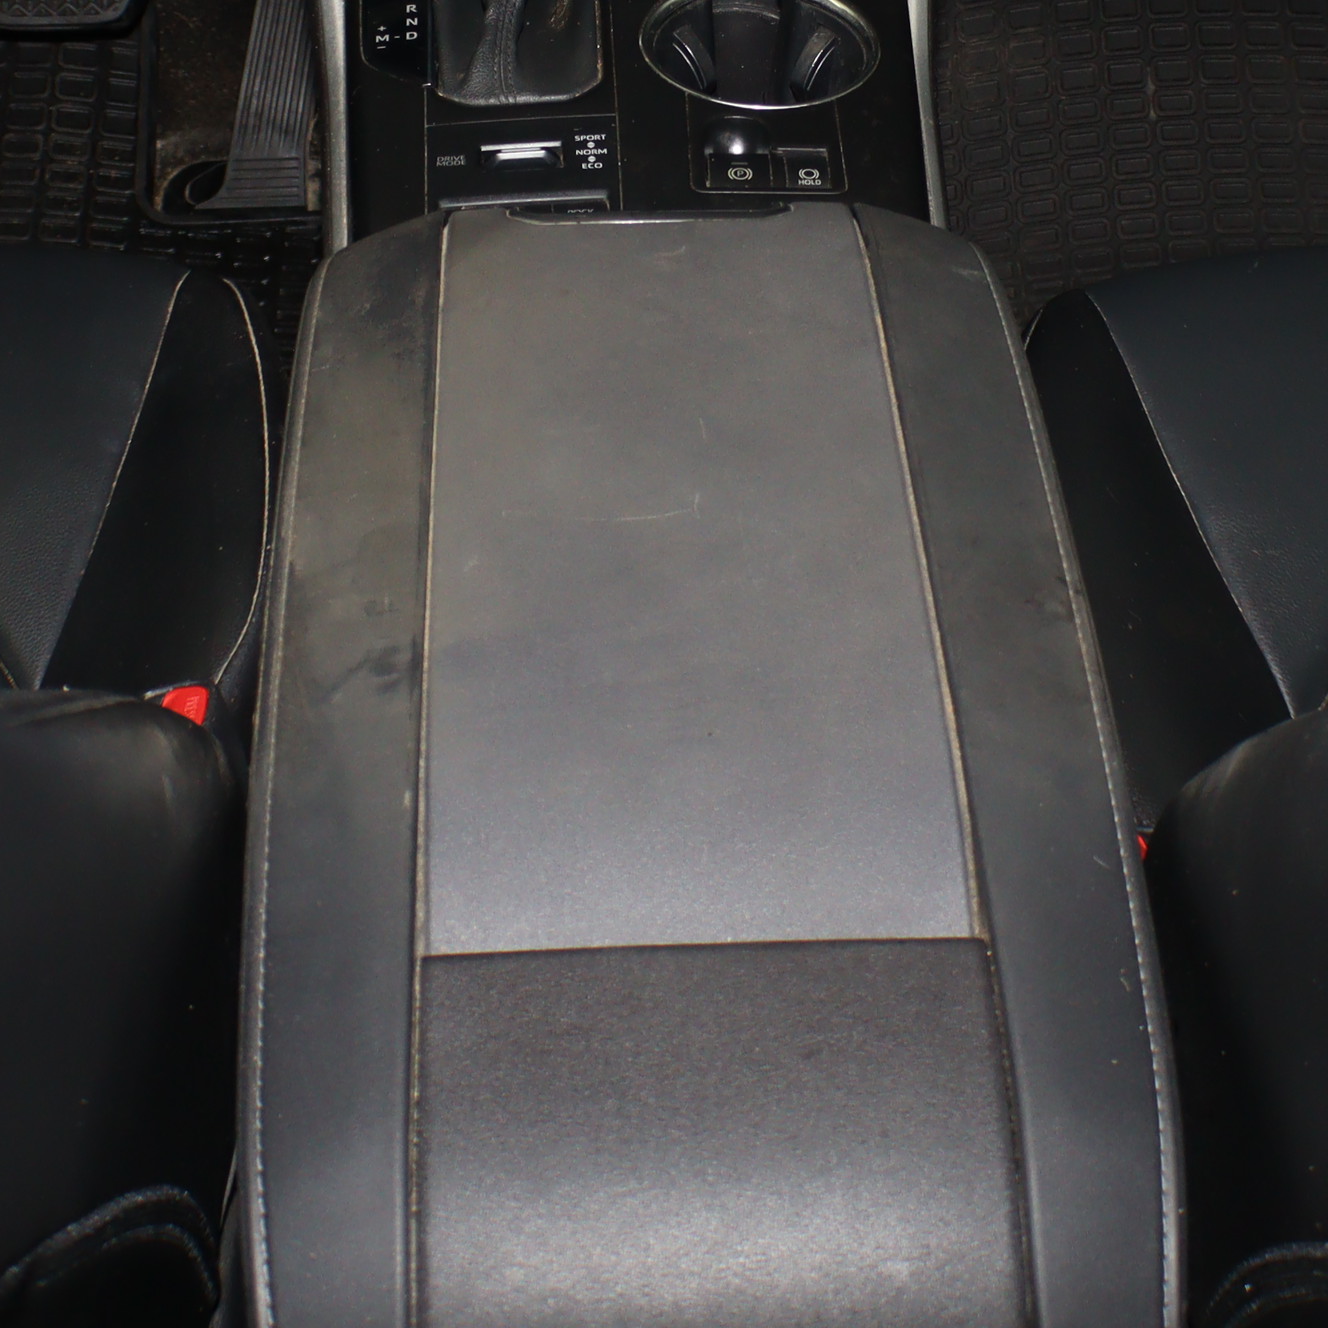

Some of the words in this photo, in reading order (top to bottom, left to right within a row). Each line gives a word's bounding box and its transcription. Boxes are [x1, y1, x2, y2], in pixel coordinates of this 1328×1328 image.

[406, 4, 418, 14] R
[405, 17, 418, 27] N
[405, 31, 418, 41] D
[574, 133, 607, 142] SPORT
[575, 148, 608, 156] NORM
[436, 154, 466, 162] DRIVE
[581, 162, 603, 170] ECO
